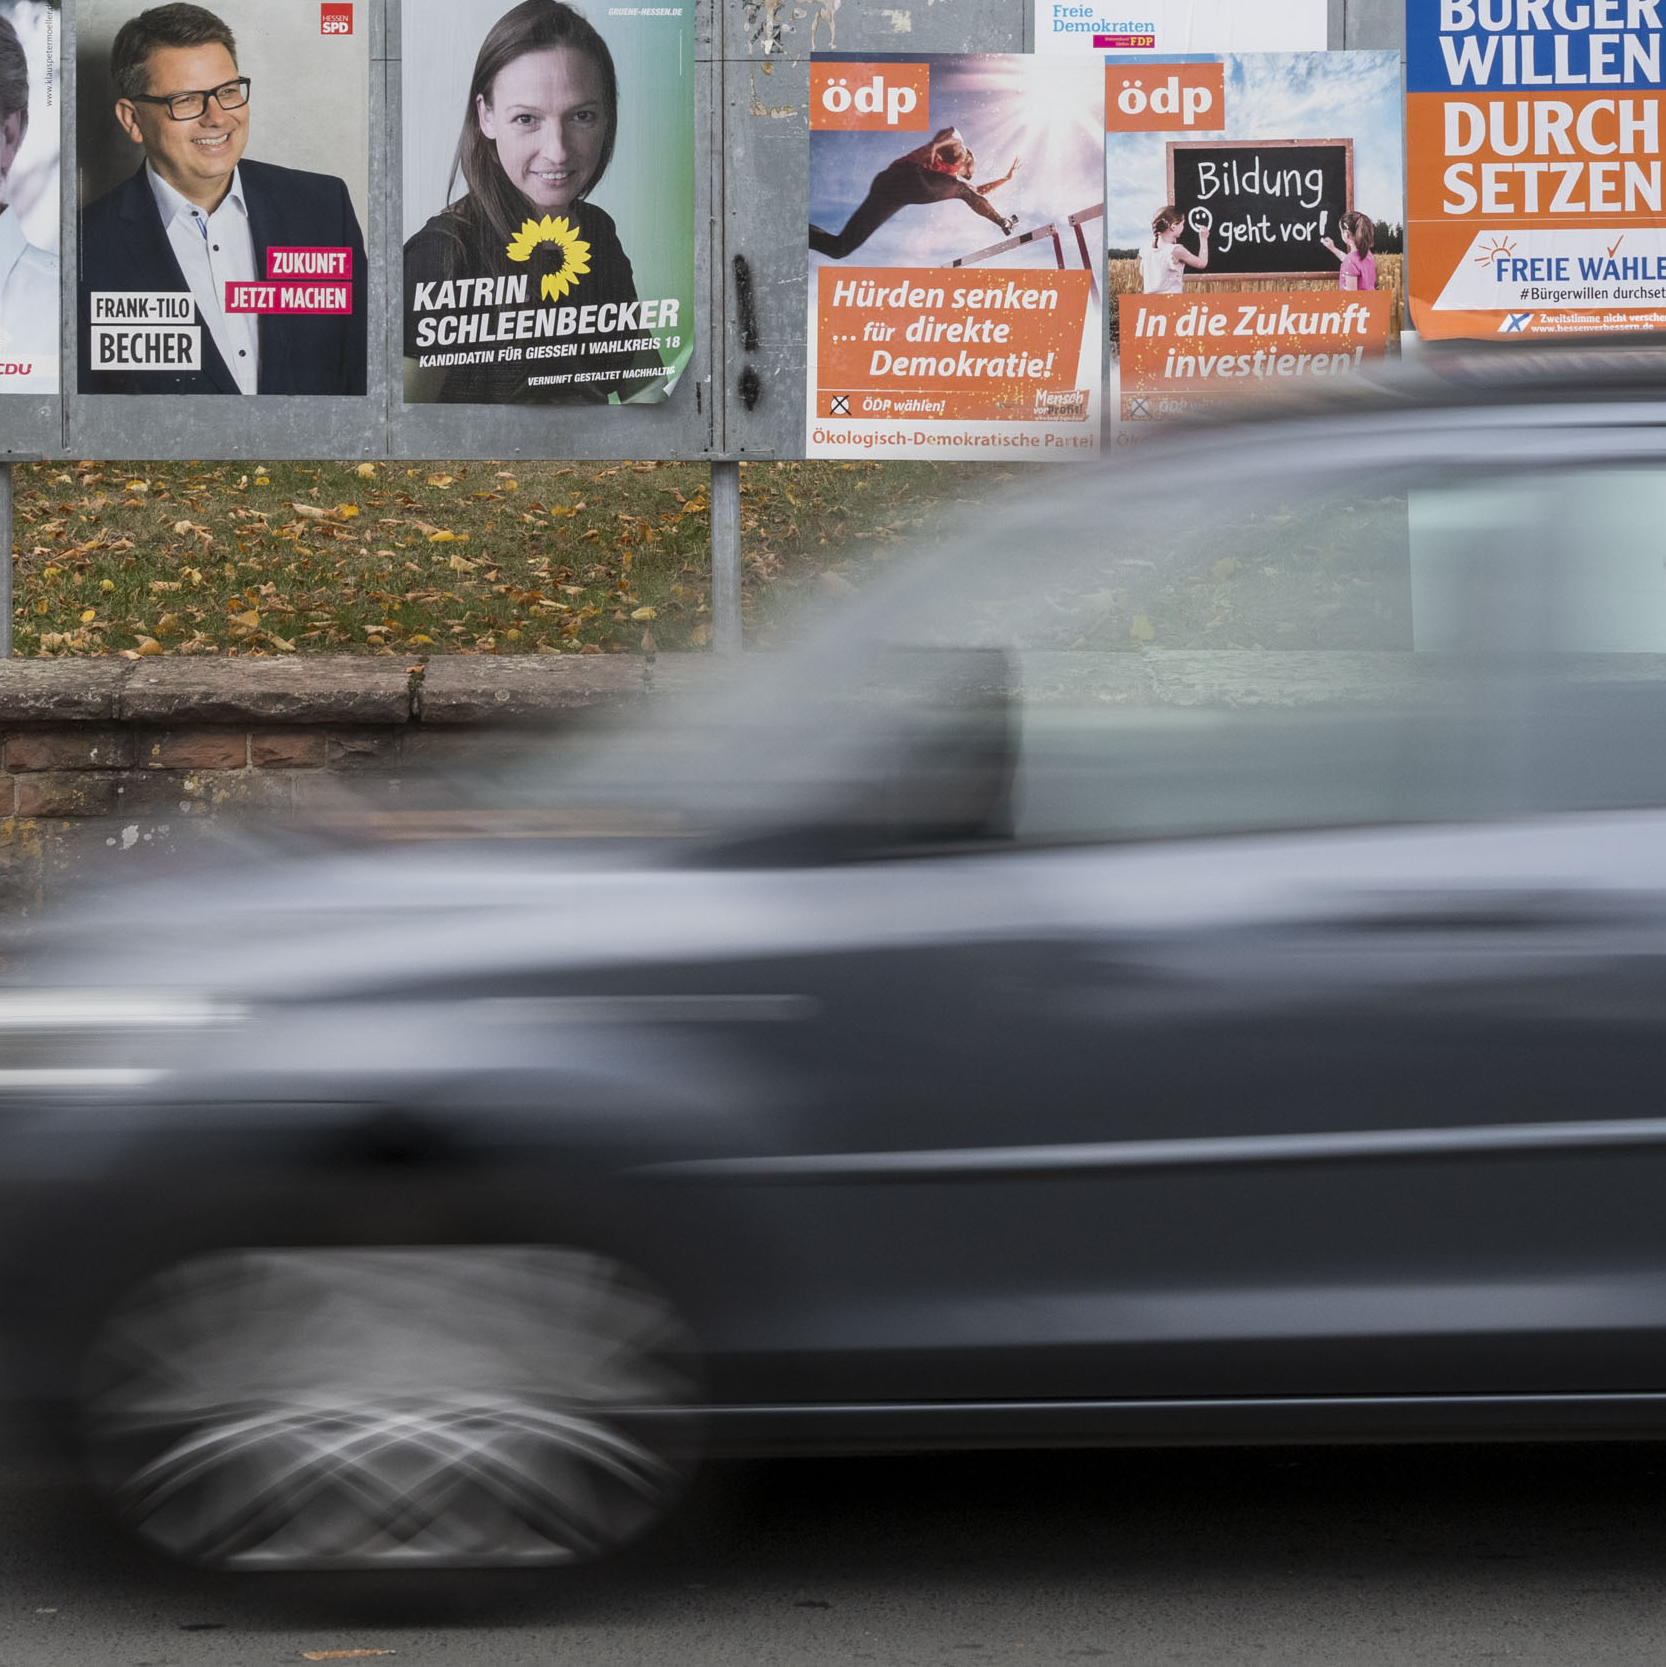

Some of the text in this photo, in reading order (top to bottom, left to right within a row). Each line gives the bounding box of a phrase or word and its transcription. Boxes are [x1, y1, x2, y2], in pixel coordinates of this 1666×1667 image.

[1053, 4, 1093, 17] Freie
[323, 22, 348, 33] SPD
[1053, 19, 1155, 32] Demokraten
[1130, 37, 1153, 46] FDP
[1438, 33, 1661, 86] WILLEN
[822, 76, 917, 125] ödp
[1118, 77, 1213, 125] ödp
[1443, 99, 1659, 157] DURCH
[1198, 157, 1323, 208] Bildung
[1443, 161, 1662, 215] SETZEN
[1219, 210, 1328, 252] geht vor!
[272, 252, 346, 275] ZUKUNFT
[1497, 257, 1570, 282] FREIE
[96, 298, 189, 318] FRANK-TILO
[231, 287, 346, 309] JETZT MACHEN
[413, 275, 529, 312] KATRIN
[833, 280, 1058, 309] Hürden senken
[416, 299, 679, 348] SCHLEENBECKER
[863, 316, 1010, 343] für direkte
[1135, 303, 1370, 337] In die Zukunft
[1531, 322, 1654, 334] www.hessenverbessern.de
[1540, 313, 1601, 324] Zweitstimme
[1604, 312, 1626, 323] nicht
[100, 332, 192, 363] BECHER
[419, 336, 680, 367] KANDIDATIN FÜR GIESSEN WAHLKREIS 18
[1165, 346, 1363, 378] investieren!
[870, 350, 1054, 378] Demokratie!
[813, 427, 1094, 449] Ökologisch-Demokratische Partei
